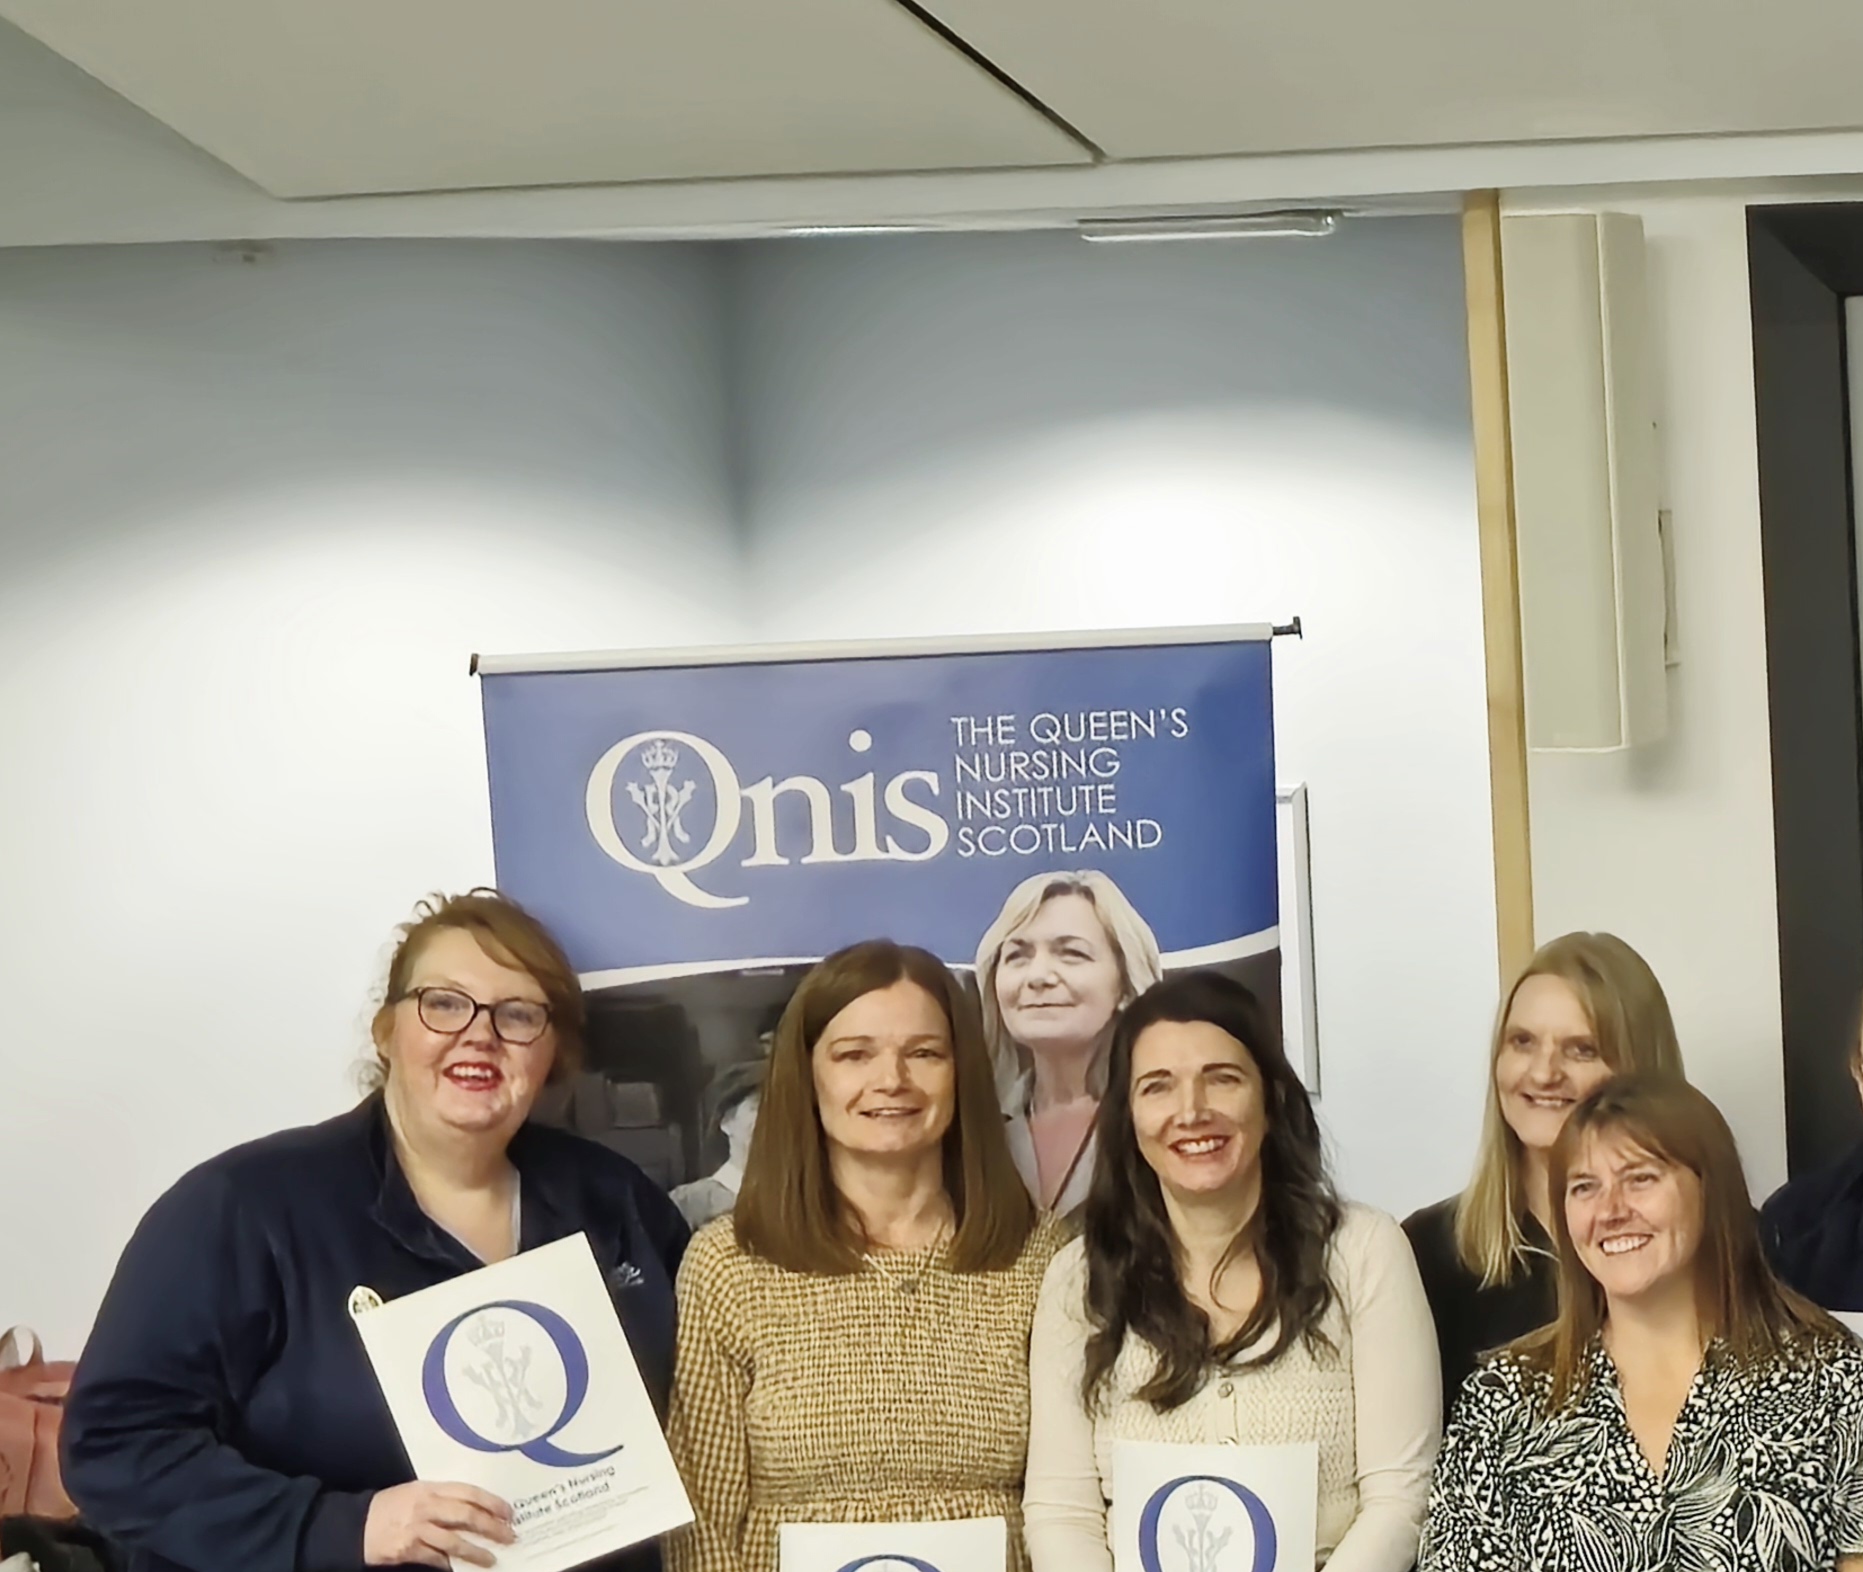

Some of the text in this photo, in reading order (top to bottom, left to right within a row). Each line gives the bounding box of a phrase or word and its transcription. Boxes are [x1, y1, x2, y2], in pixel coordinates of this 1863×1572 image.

[951, 707, 1189, 747] THE QUEEN'S
[955, 748, 1121, 783] NURSING
[584, 728, 950, 909] Qnis
[957, 783, 1117, 818] INSTITUTE
[957, 820, 1163, 858] SCOTLAND
[422, 1300, 624, 1468] Q
